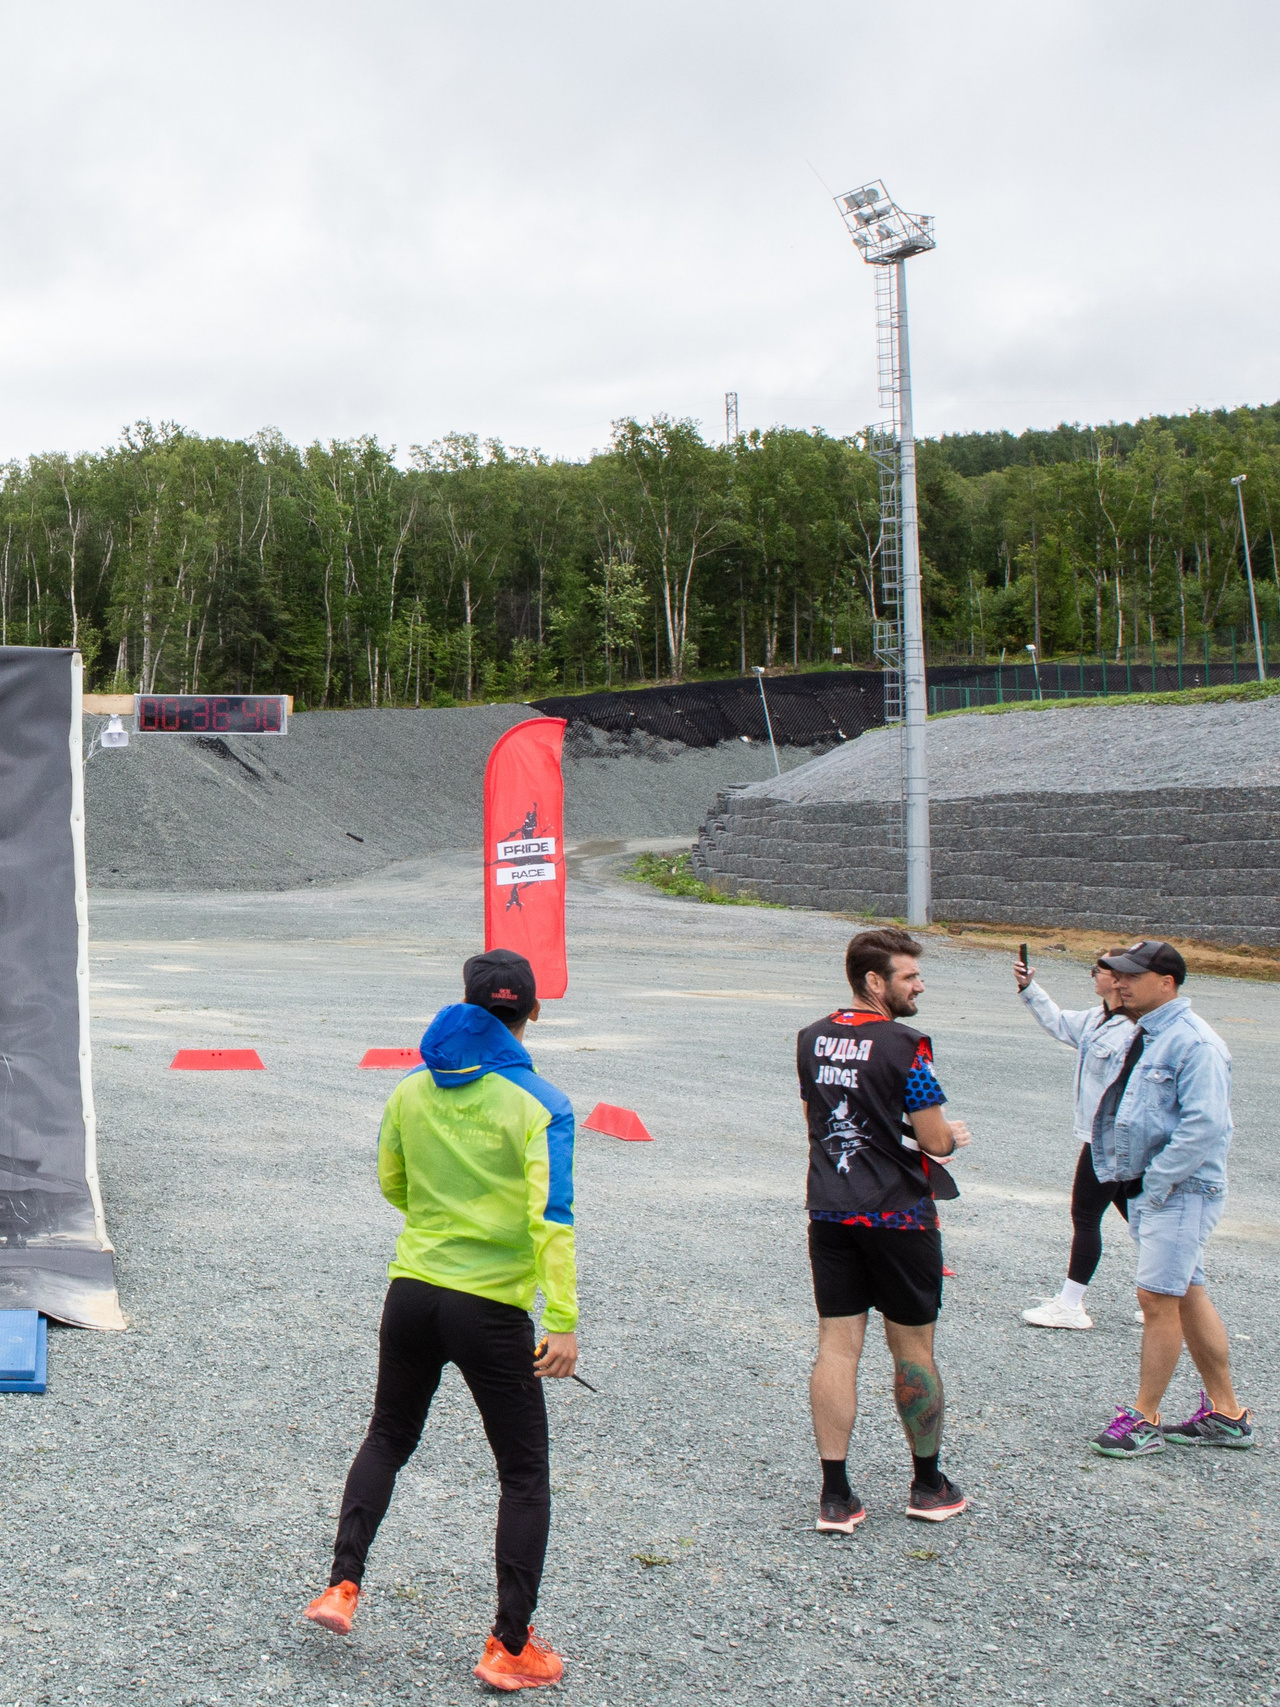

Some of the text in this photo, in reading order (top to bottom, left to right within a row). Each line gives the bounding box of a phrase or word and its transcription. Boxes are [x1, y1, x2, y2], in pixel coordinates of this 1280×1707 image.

[141, 698, 281, 731] 00:36:40
[503, 842, 550, 856] PRIDE
[511, 868, 545, 880] RACE
[814, 1035, 873, 1063] СУДЬЯ
